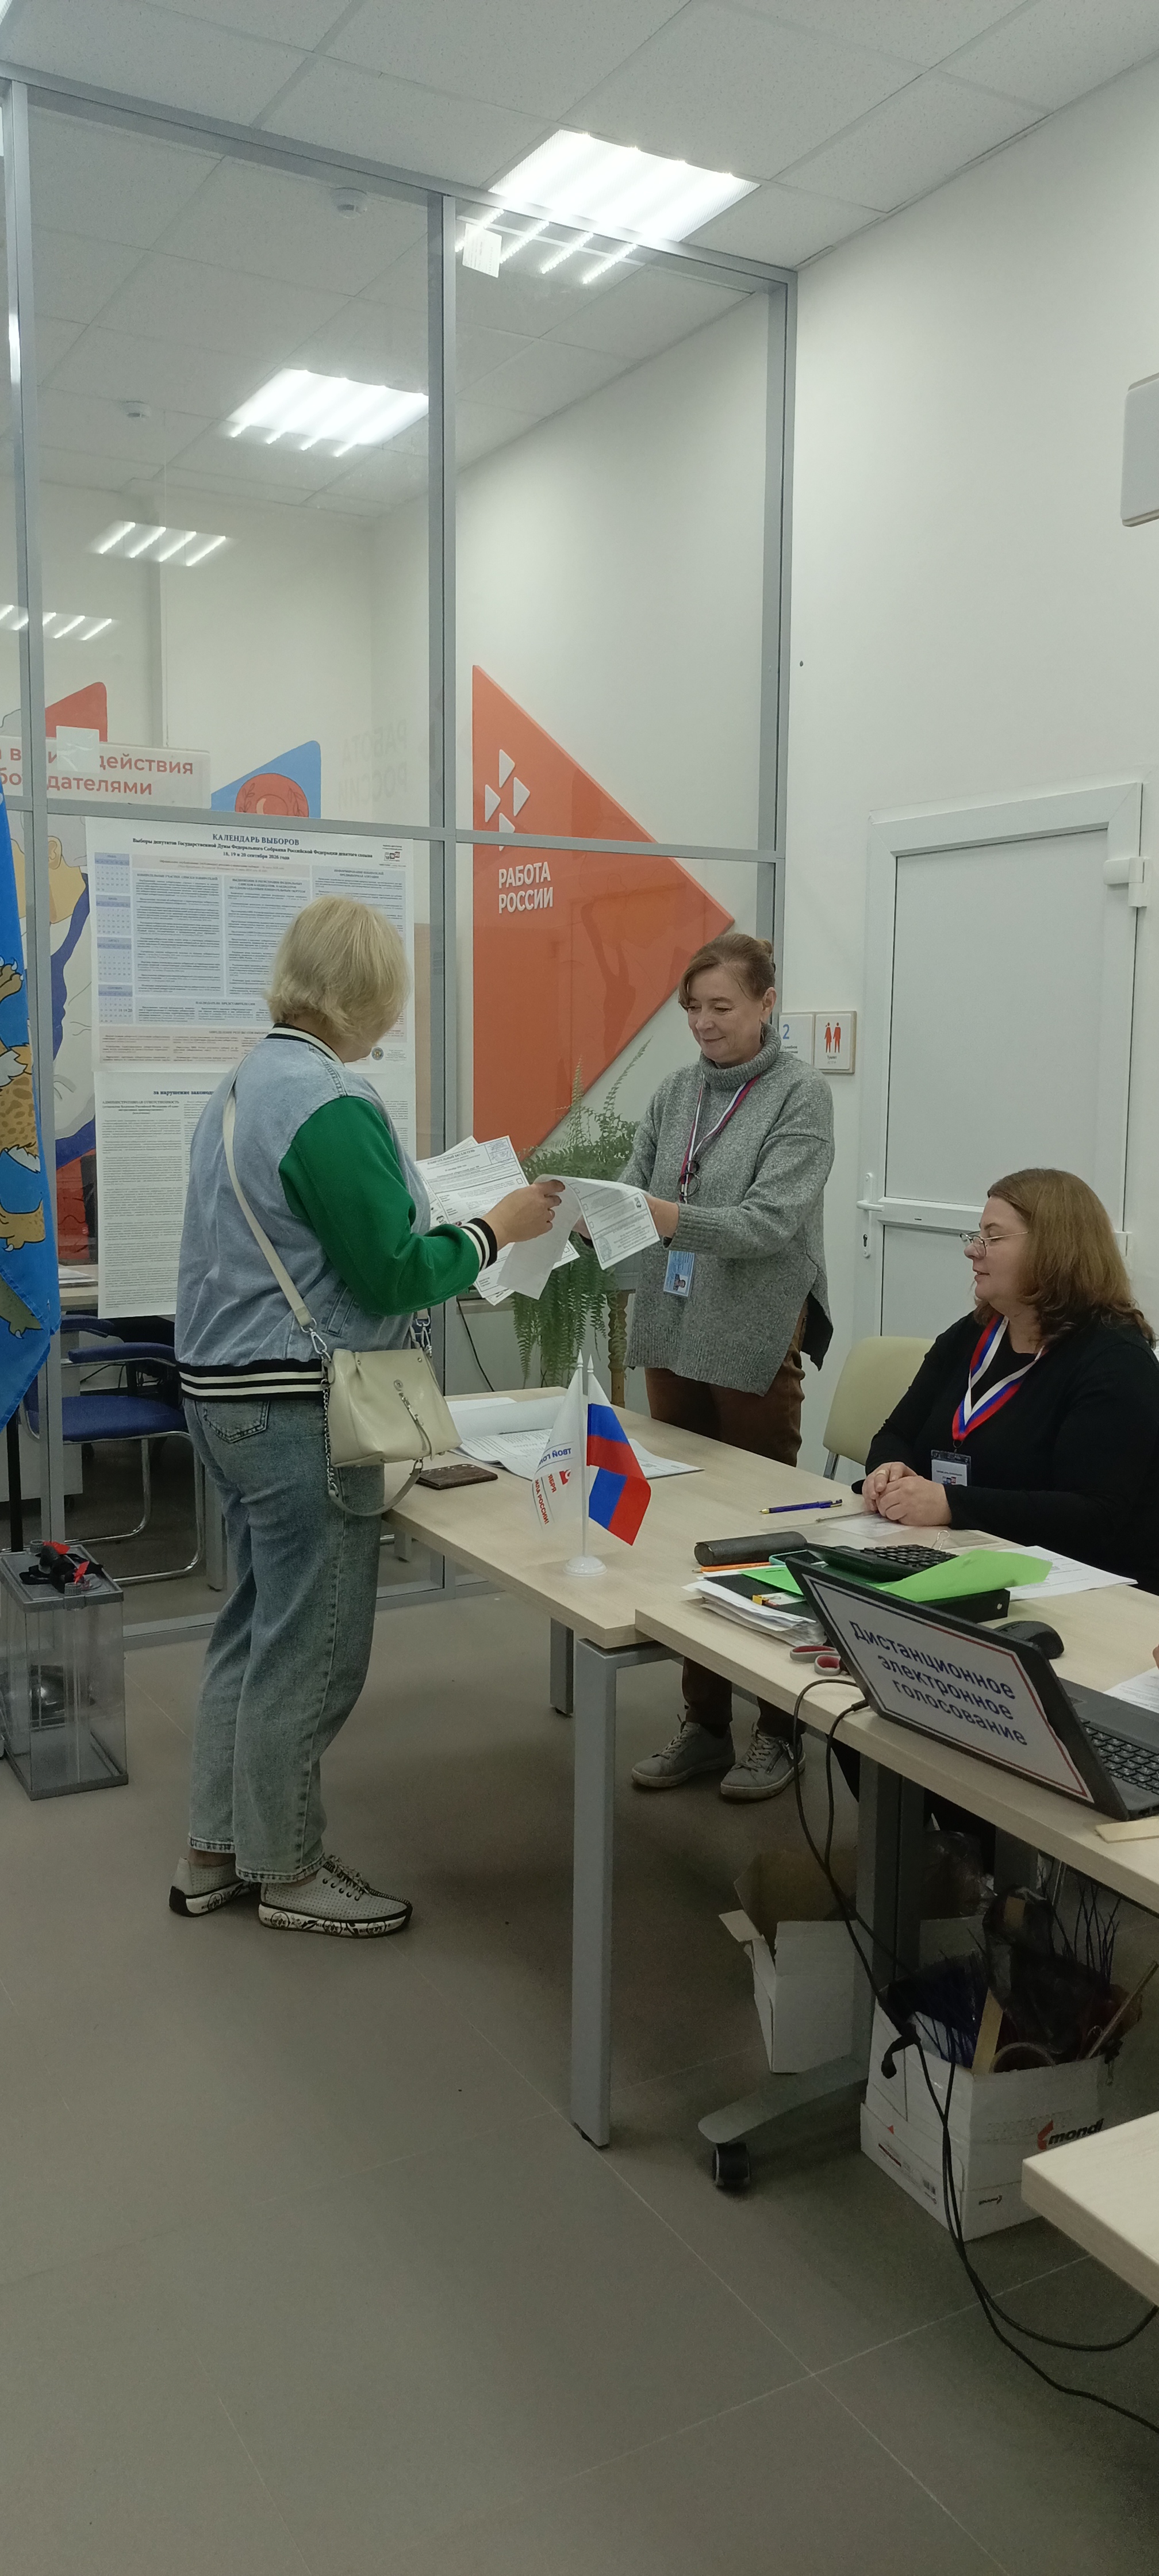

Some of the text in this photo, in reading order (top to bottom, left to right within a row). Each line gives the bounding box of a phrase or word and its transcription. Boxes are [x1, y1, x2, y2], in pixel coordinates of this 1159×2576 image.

[212, 834, 300, 845] КАЛЕНДАРЬ ВЫБОРОВ
[498, 861, 551, 888] РАБОТА
[498, 887, 553, 914] РОССИИ
[782, 1024, 789, 1039] 2
[538, 1494, 550, 1525] РОССИИ!
[849, 1620, 1015, 1700] Дистанционное
[878, 1655, 1014, 1720] электронное
[893, 1680, 1027, 1746] голосование
[1048, 2117, 1105, 2145] mondi
